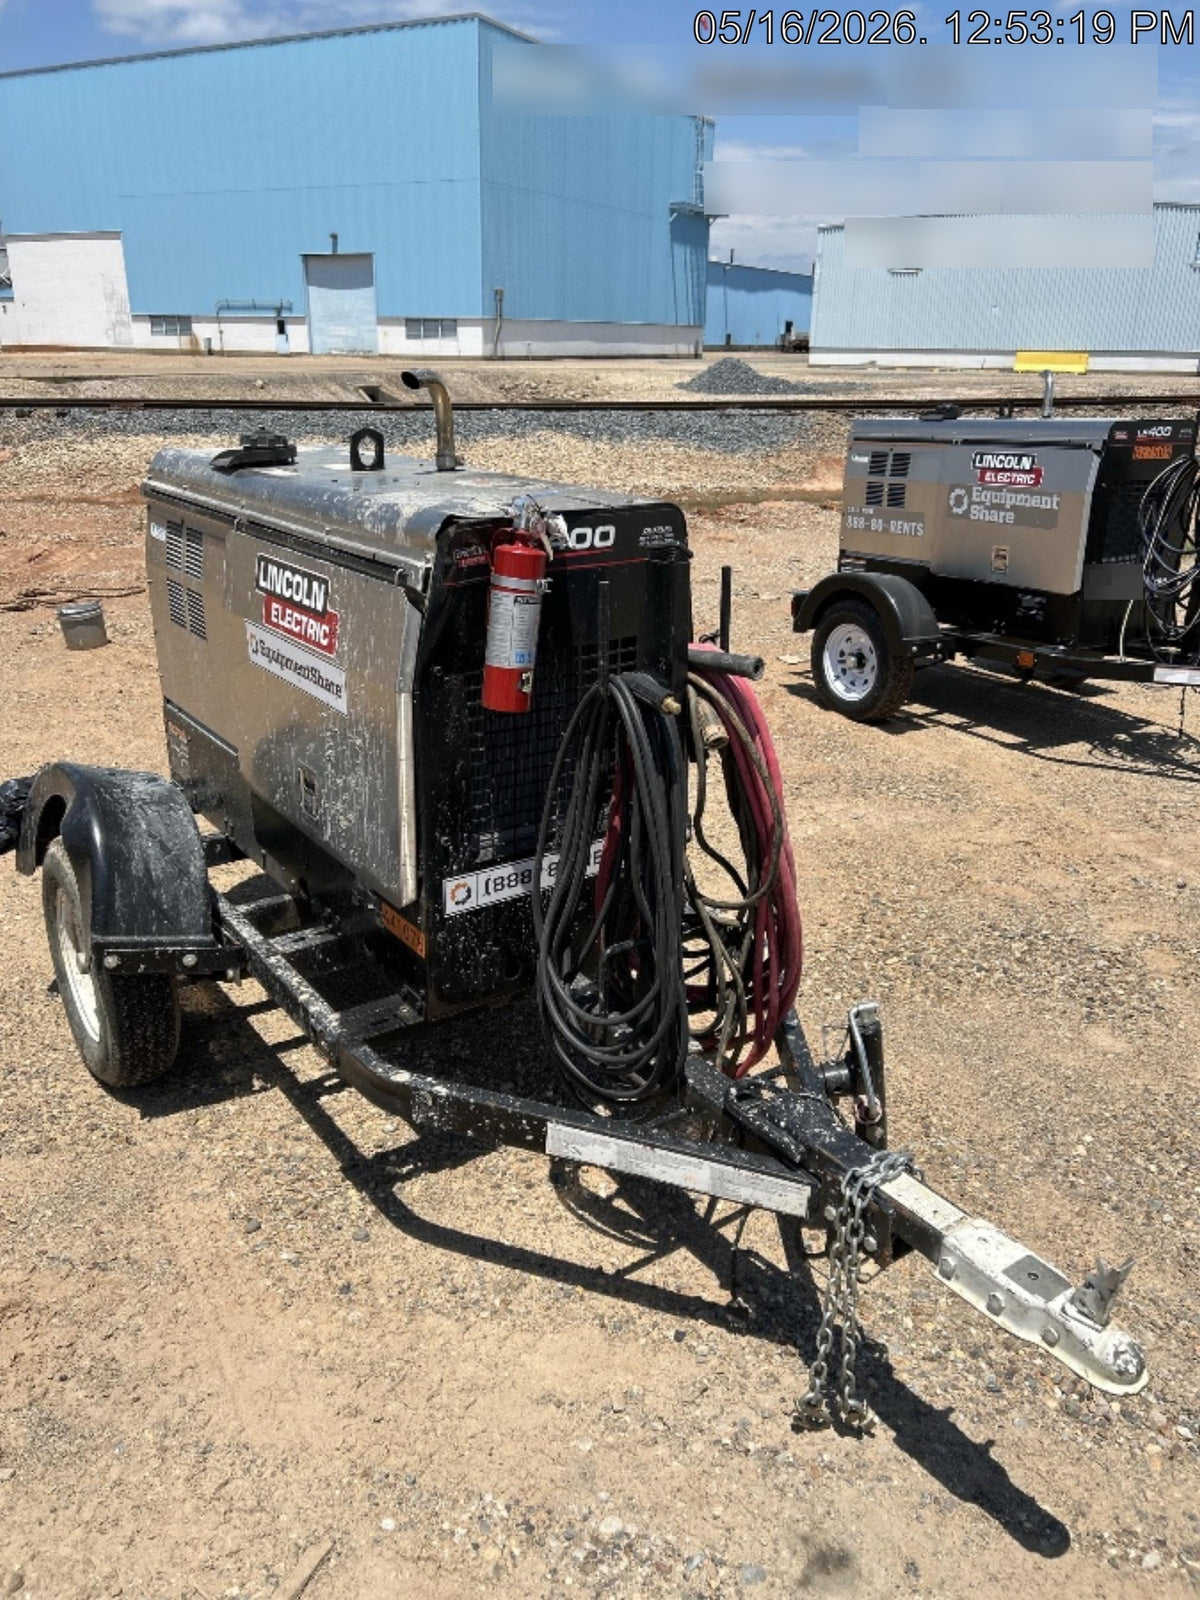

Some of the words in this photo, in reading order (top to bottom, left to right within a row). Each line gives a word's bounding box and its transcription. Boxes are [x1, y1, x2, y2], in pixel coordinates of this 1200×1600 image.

[975, 454, 1032, 470] LINCOLN
[984, 472, 1036, 485] ELECTRIC
[972, 486, 1060, 510] Equipment
[970, 504, 1015, 524] Share
[567, 525, 616, 550] 00
[258, 561, 326, 613] LINCOLN
[270, 602, 330, 647] ELECTRIC
[258, 639, 342, 699] EquipmentShare
[484, 868, 534, 897] (888
